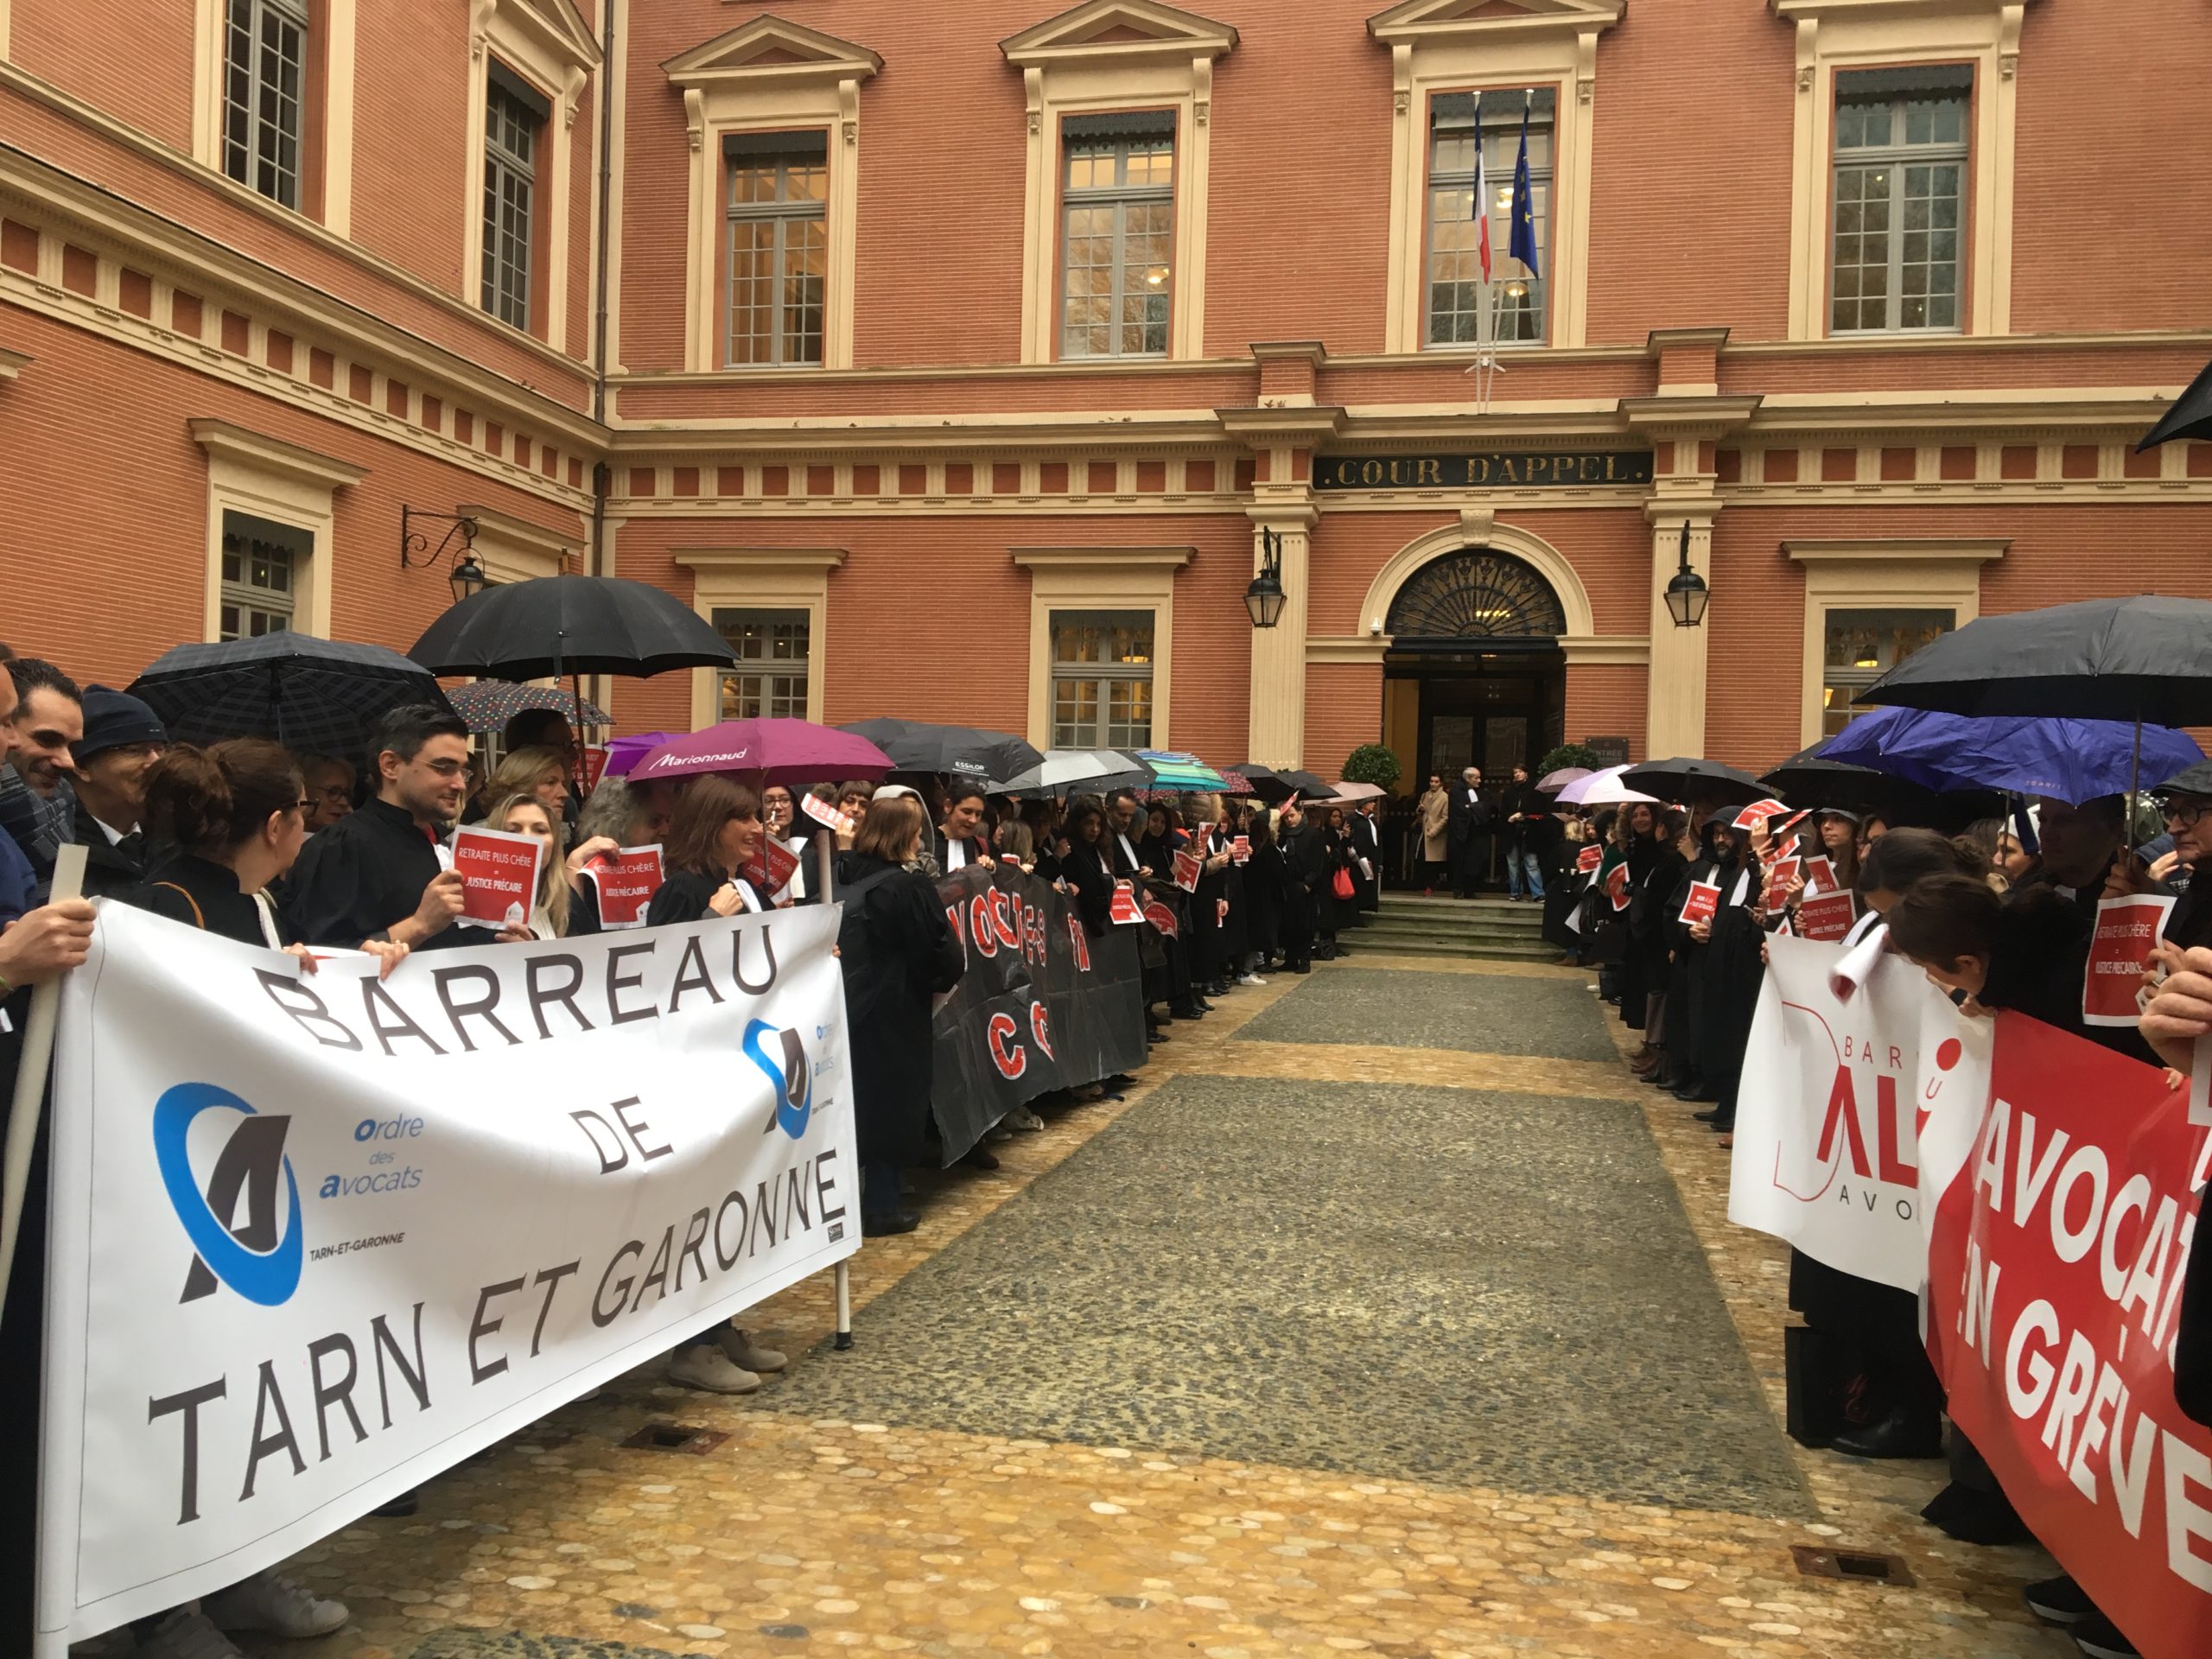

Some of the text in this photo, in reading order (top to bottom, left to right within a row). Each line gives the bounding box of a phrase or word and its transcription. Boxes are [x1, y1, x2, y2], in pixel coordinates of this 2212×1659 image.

[1338, 454, 1628, 485] COUR D'APPEL
[648, 747, 747, 771] Marionnaud
[1595, 748, 1624, 757] NTRÉE
[459, 847, 532, 868] RETRAITE PLUS CHÈRE
[627, 862, 655, 874] CHÈRE
[466, 876, 523, 893] JUSTICE PRÉCAIRE
[2127, 920, 2152, 938] CHÈRE
[251, 925, 779, 1057] BARREAU
[569, 1096, 672, 1175] DE
[369, 1150, 395, 1166] des
[318, 1166, 423, 1199] avocats
[1839, 1184, 1920, 1224] AVO
[309, 1232, 406, 1262] TARN-ET-GARONNE
[1975, 1097, 2197, 1374] AVOCAT
[148, 1148, 847, 1527] TARN ET GARONNE
